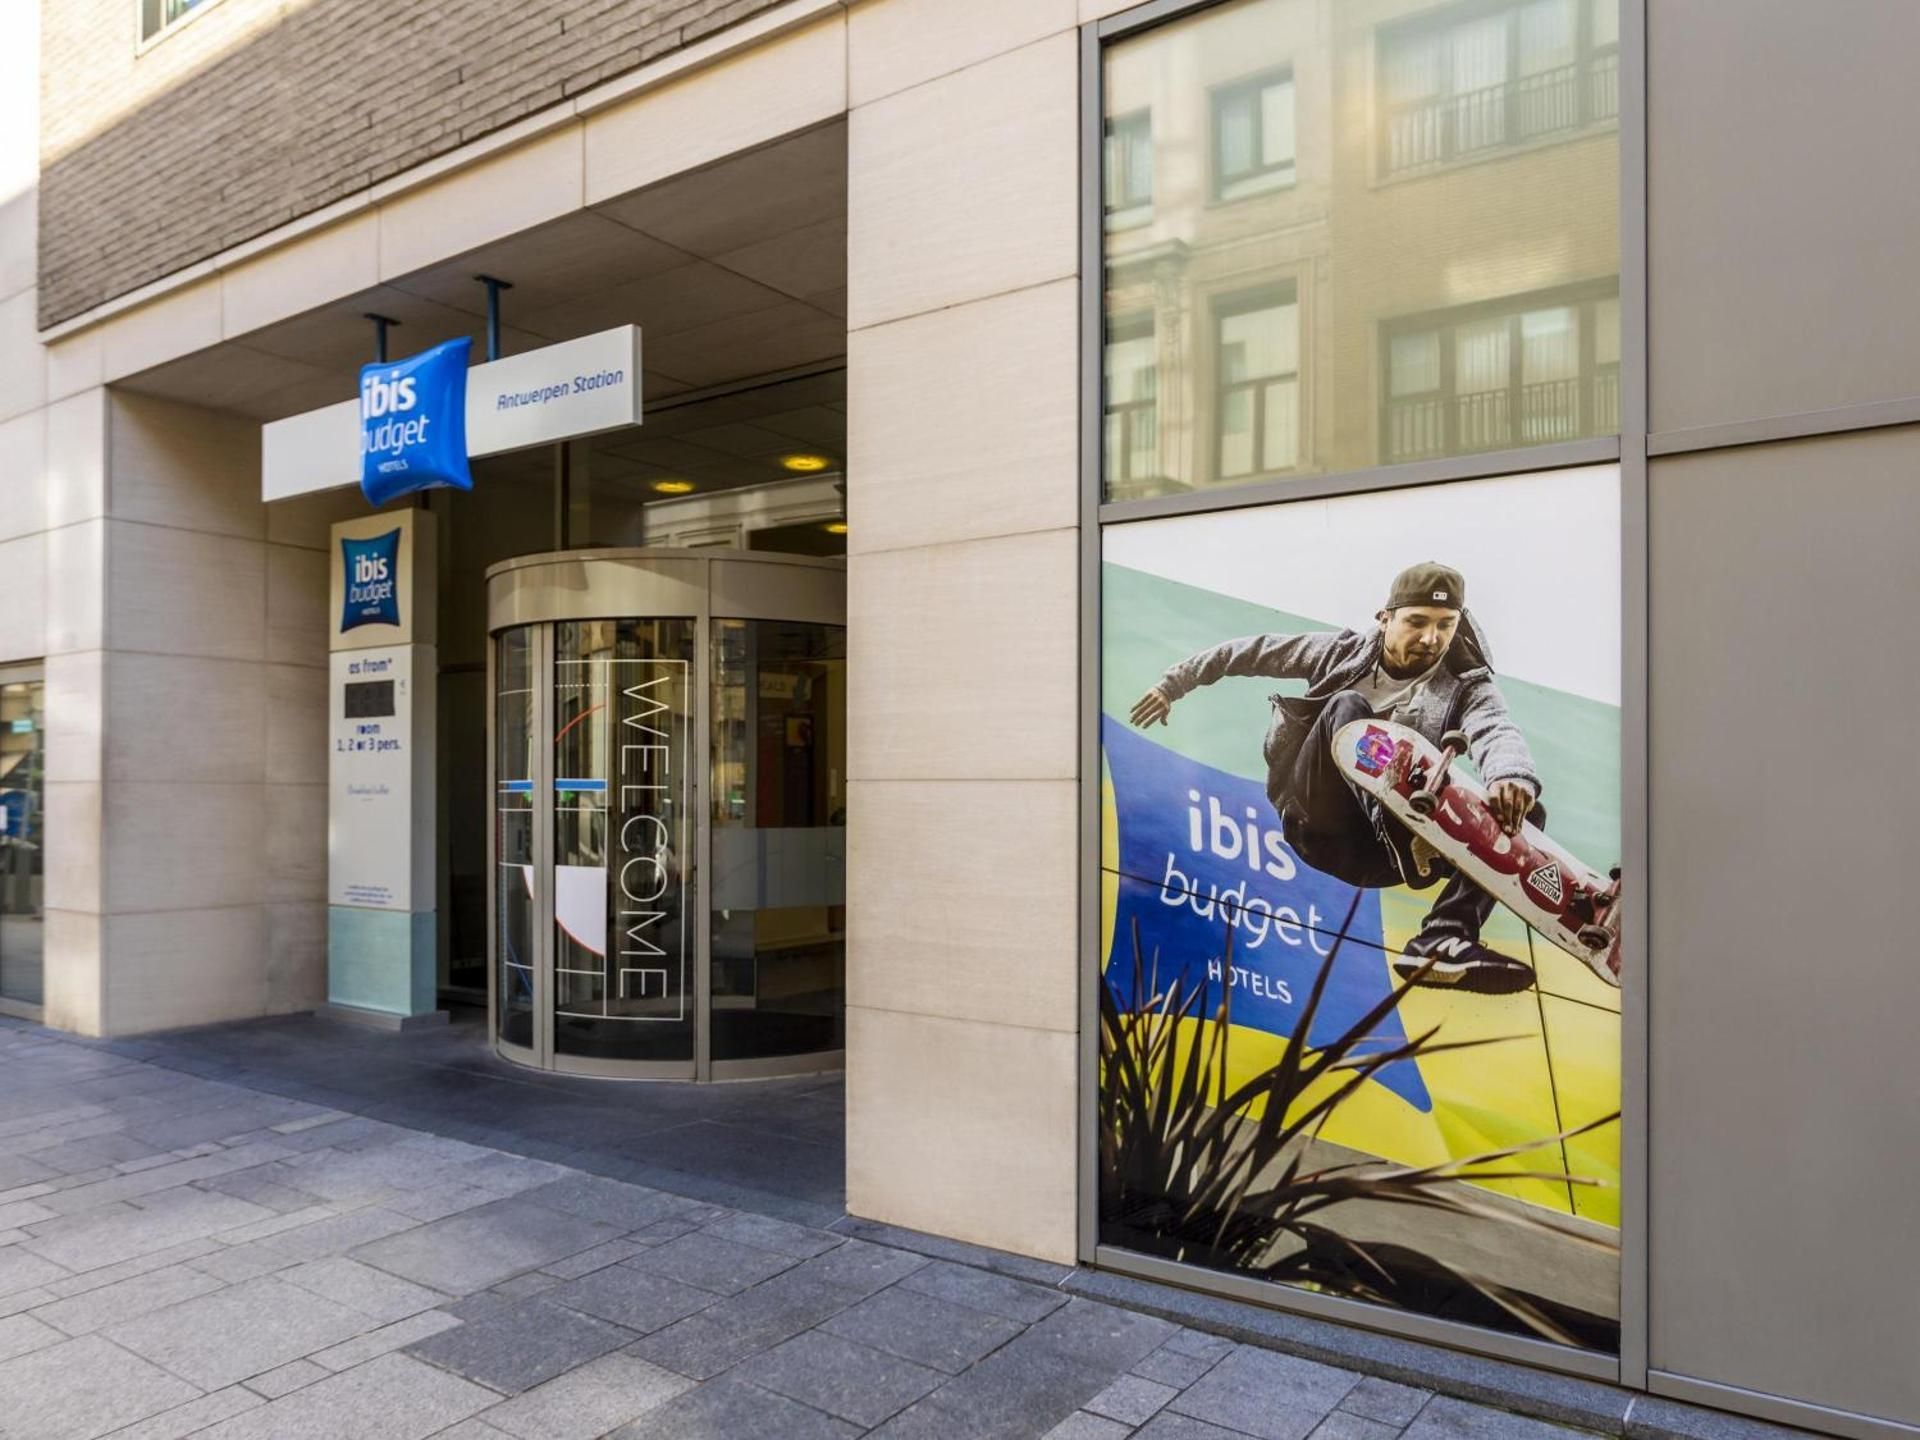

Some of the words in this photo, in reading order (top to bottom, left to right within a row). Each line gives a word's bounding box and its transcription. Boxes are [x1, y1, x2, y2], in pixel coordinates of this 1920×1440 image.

[362, 370, 417, 420] ibis
[497, 383, 569, 410] Antwerpen
[573, 369, 624, 394] Station
[355, 552, 388, 583] ibis
[349, 580, 392, 605] budget
[621, 676, 670, 998] WELCOME
[1189, 789, 1297, 881] ibis
[1160, 852, 1330, 956] budget
[1530, 873, 1561, 903] WISDOM
